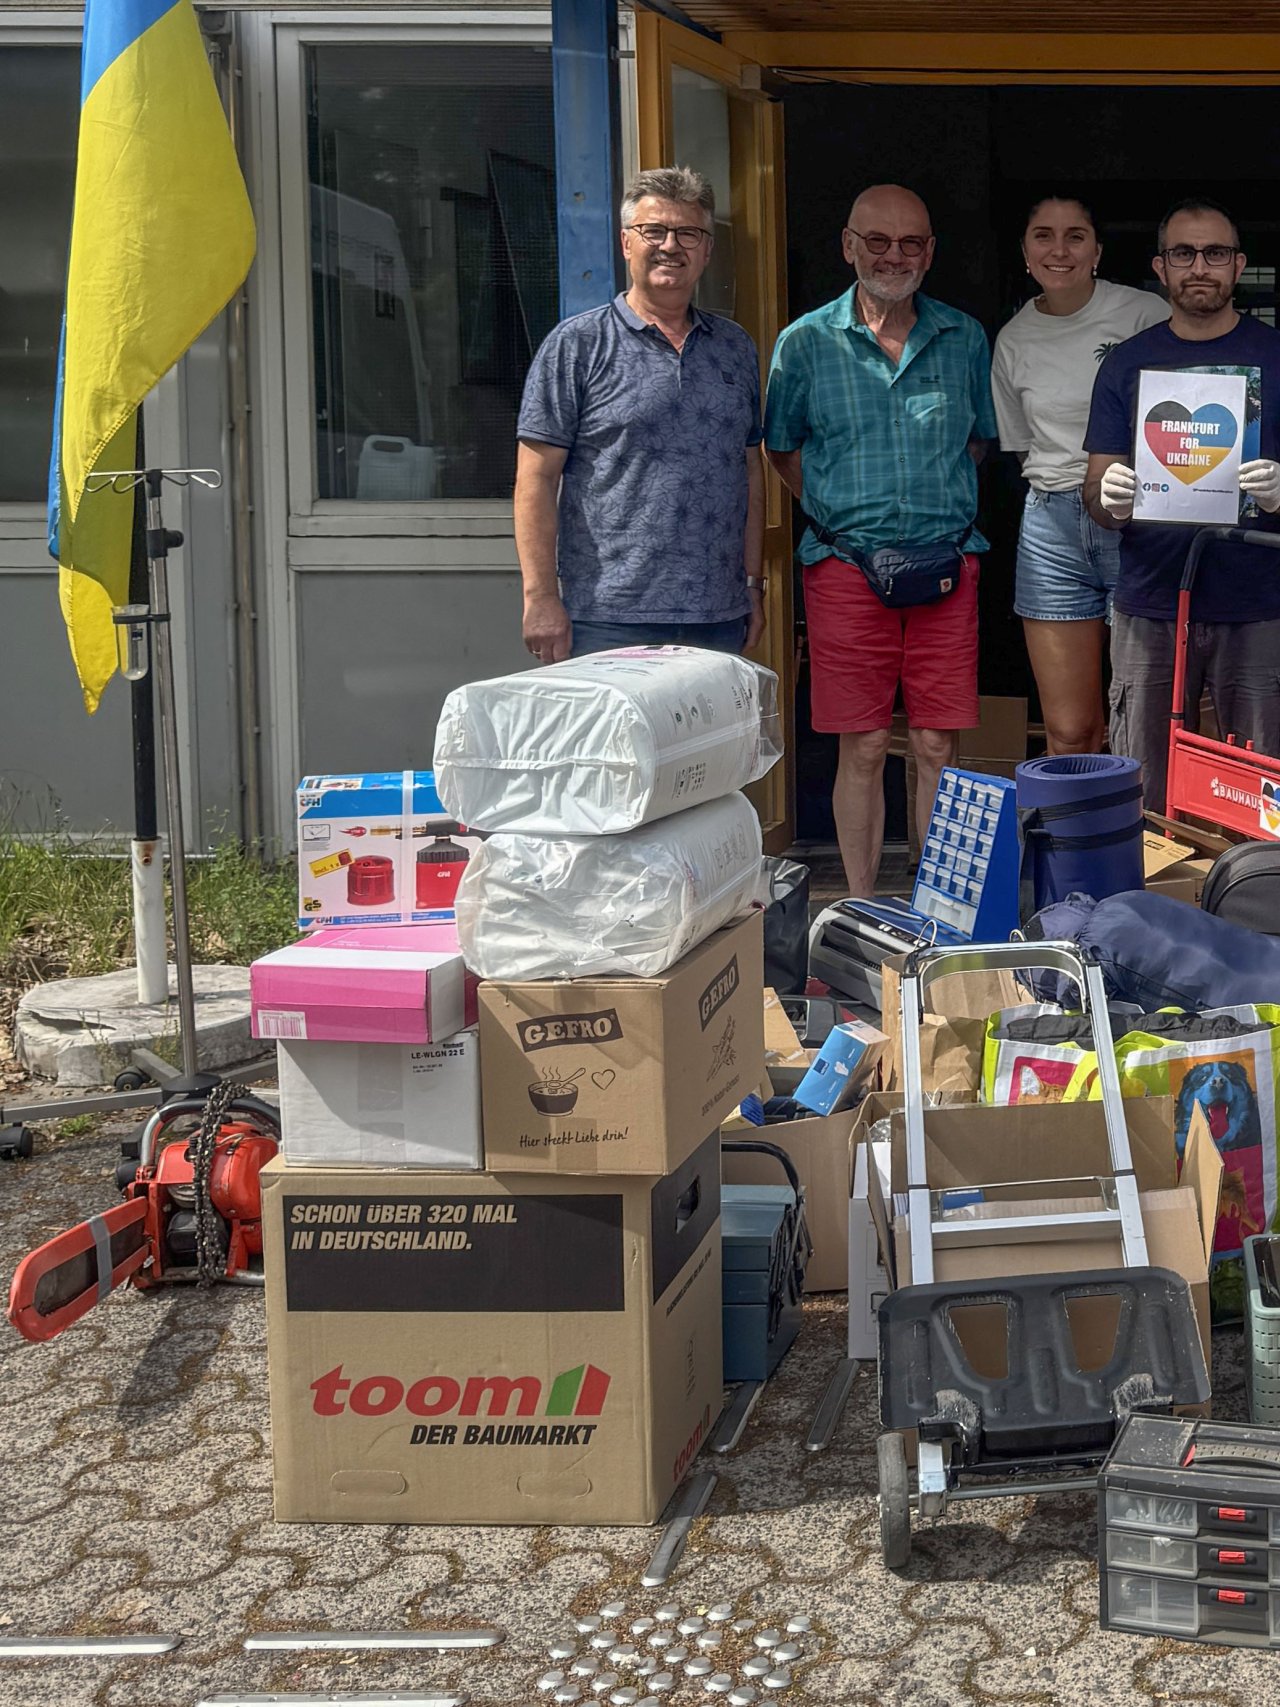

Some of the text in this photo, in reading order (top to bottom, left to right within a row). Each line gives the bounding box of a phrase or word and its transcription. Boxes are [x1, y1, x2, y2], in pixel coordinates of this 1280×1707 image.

[1161, 420, 1220, 435] FRANKFURT
[1179, 437, 1200, 449] FOR
[1166, 452, 1211, 466] UKRAINE
[300, 797, 321, 807] CFH
[304, 899, 322, 912] GS
[315, 915, 333, 924] CFH
[701, 965, 736, 1019] GEFRO
[524, 1016, 613, 1045] GEFRO
[411, 1050, 447, 1060] LE-WLGN
[448, 1049, 458, 1057] 22
[520, 1127, 629, 1147] Hier steckt Liebe drin!
[291, 1204, 361, 1224] SCHON
[427, 1204, 467, 1224] 320
[472, 1203, 518, 1224] MAL
[291, 1230, 472, 1251] IN DEUTSCHLAND.
[310, 1362, 543, 1418] toom
[410, 1424, 598, 1446] DER BAUMARKT
